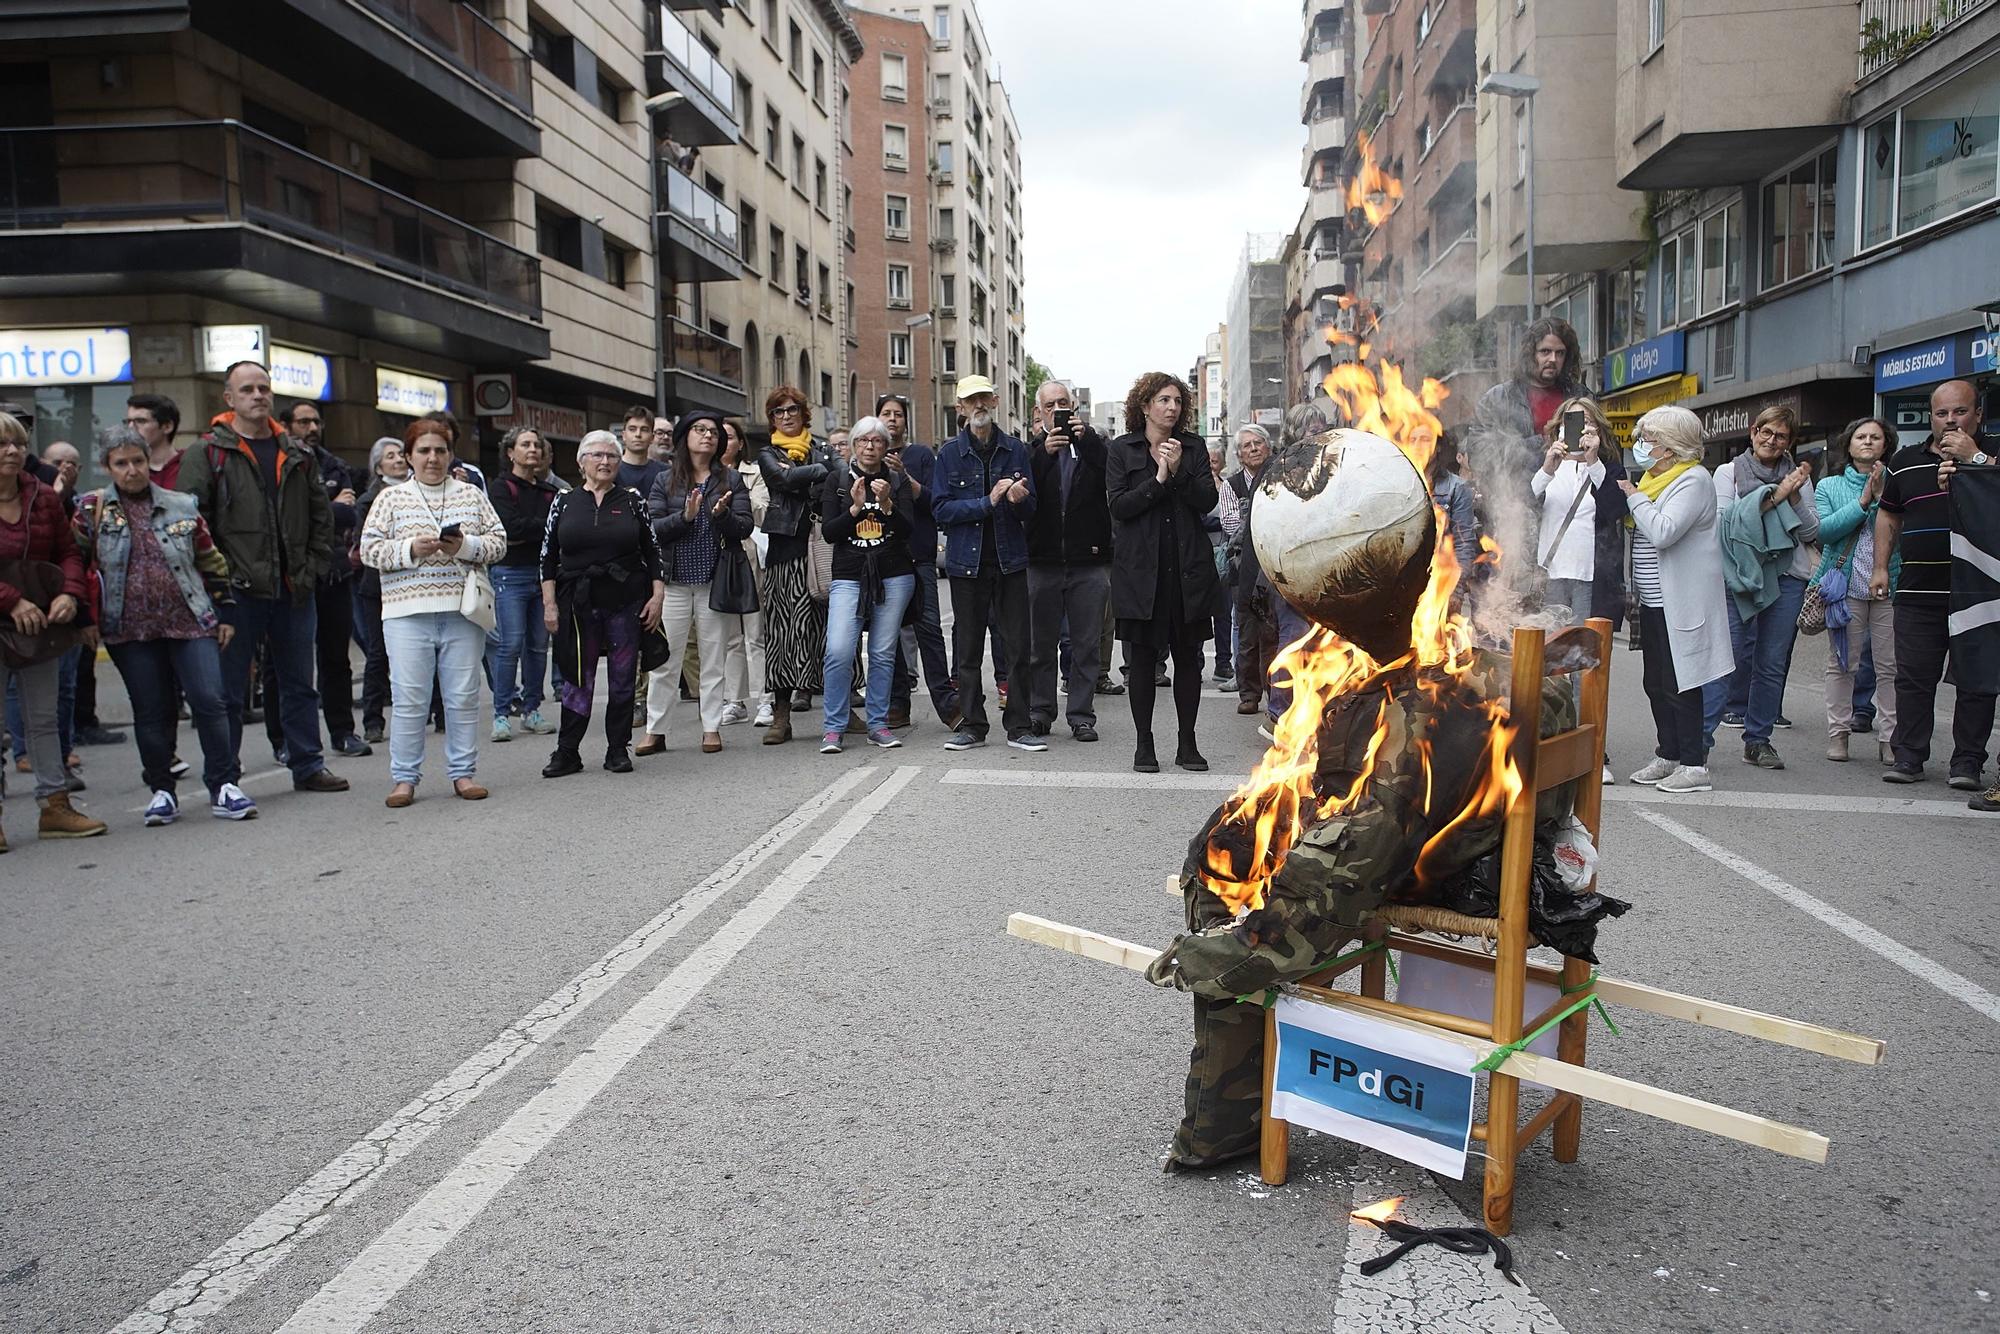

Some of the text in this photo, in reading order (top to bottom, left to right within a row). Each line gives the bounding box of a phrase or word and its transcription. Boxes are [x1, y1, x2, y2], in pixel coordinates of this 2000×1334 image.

[1631, 346, 1658, 379] pelayo
[1882, 346, 1946, 378] MÒBILS ESTACIÓ
[1309, 1048, 1425, 1111] FPdGi
